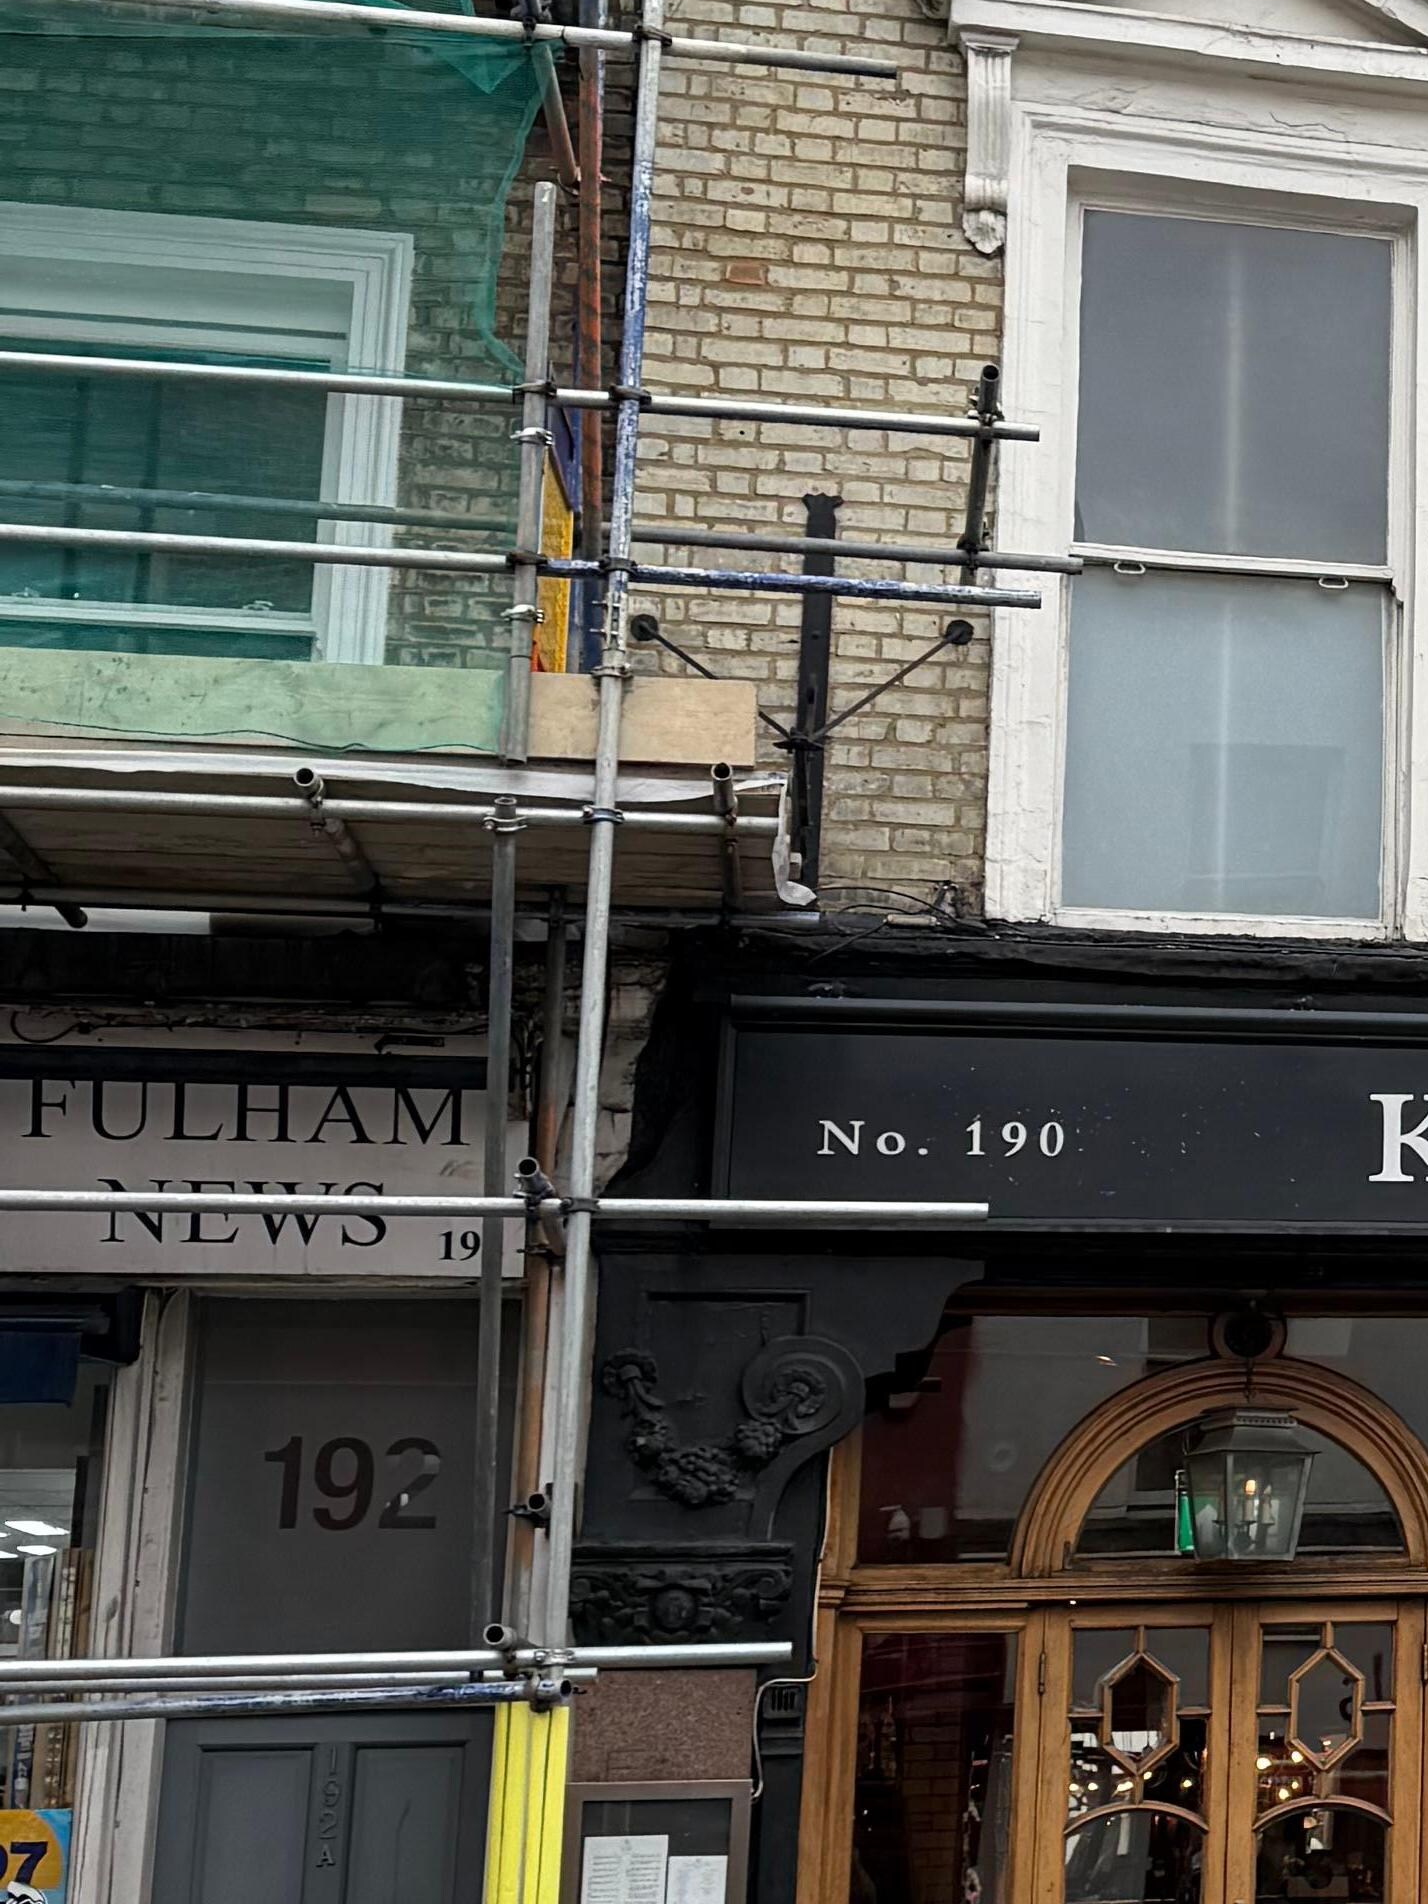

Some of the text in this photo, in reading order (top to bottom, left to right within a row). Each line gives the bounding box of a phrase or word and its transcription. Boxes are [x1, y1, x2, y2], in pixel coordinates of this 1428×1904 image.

[20, 1078, 472, 1147] FULHAM
[817, 1116, 1065, 1158] No. 190
[97, 1178, 388, 1248] NEWS
[439, 1230, 482, 1262] 19
[264, 1436, 442, 1531] 192
[316, 1744, 340, 1868] 192A
[0, 1841, 48, 1887] 7
